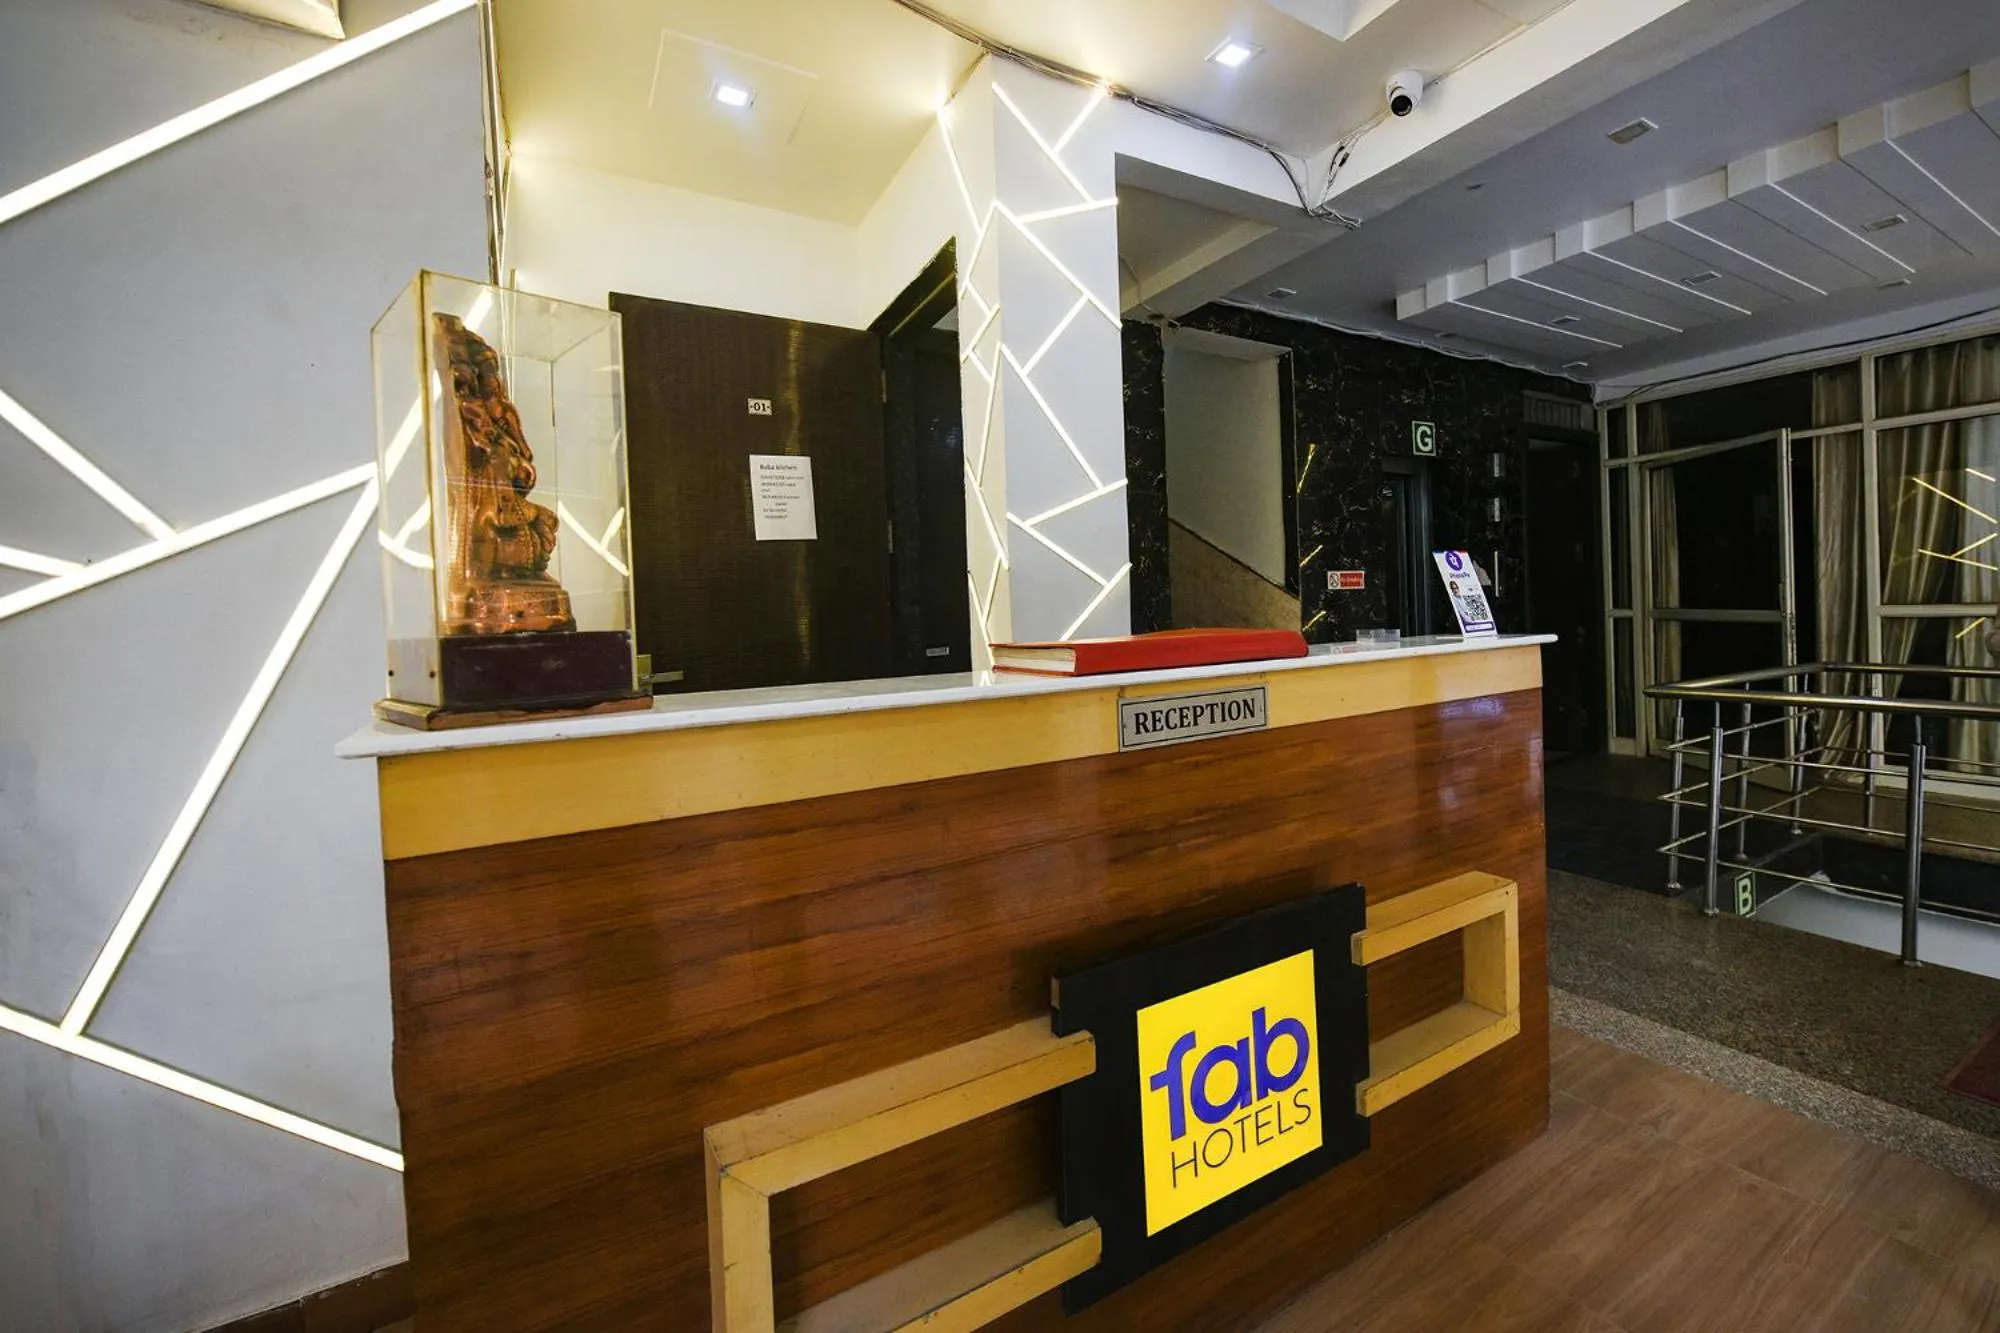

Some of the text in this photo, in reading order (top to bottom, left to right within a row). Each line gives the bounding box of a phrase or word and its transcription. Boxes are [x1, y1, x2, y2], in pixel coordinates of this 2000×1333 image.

[1416, 425, 1432, 451] G
[1134, 698, 1256, 735] RECEPTION
[1738, 877, 1753, 916] B
[1150, 1006, 1310, 1142] fab
[1171, 1088, 1312, 1188] HOTELS
